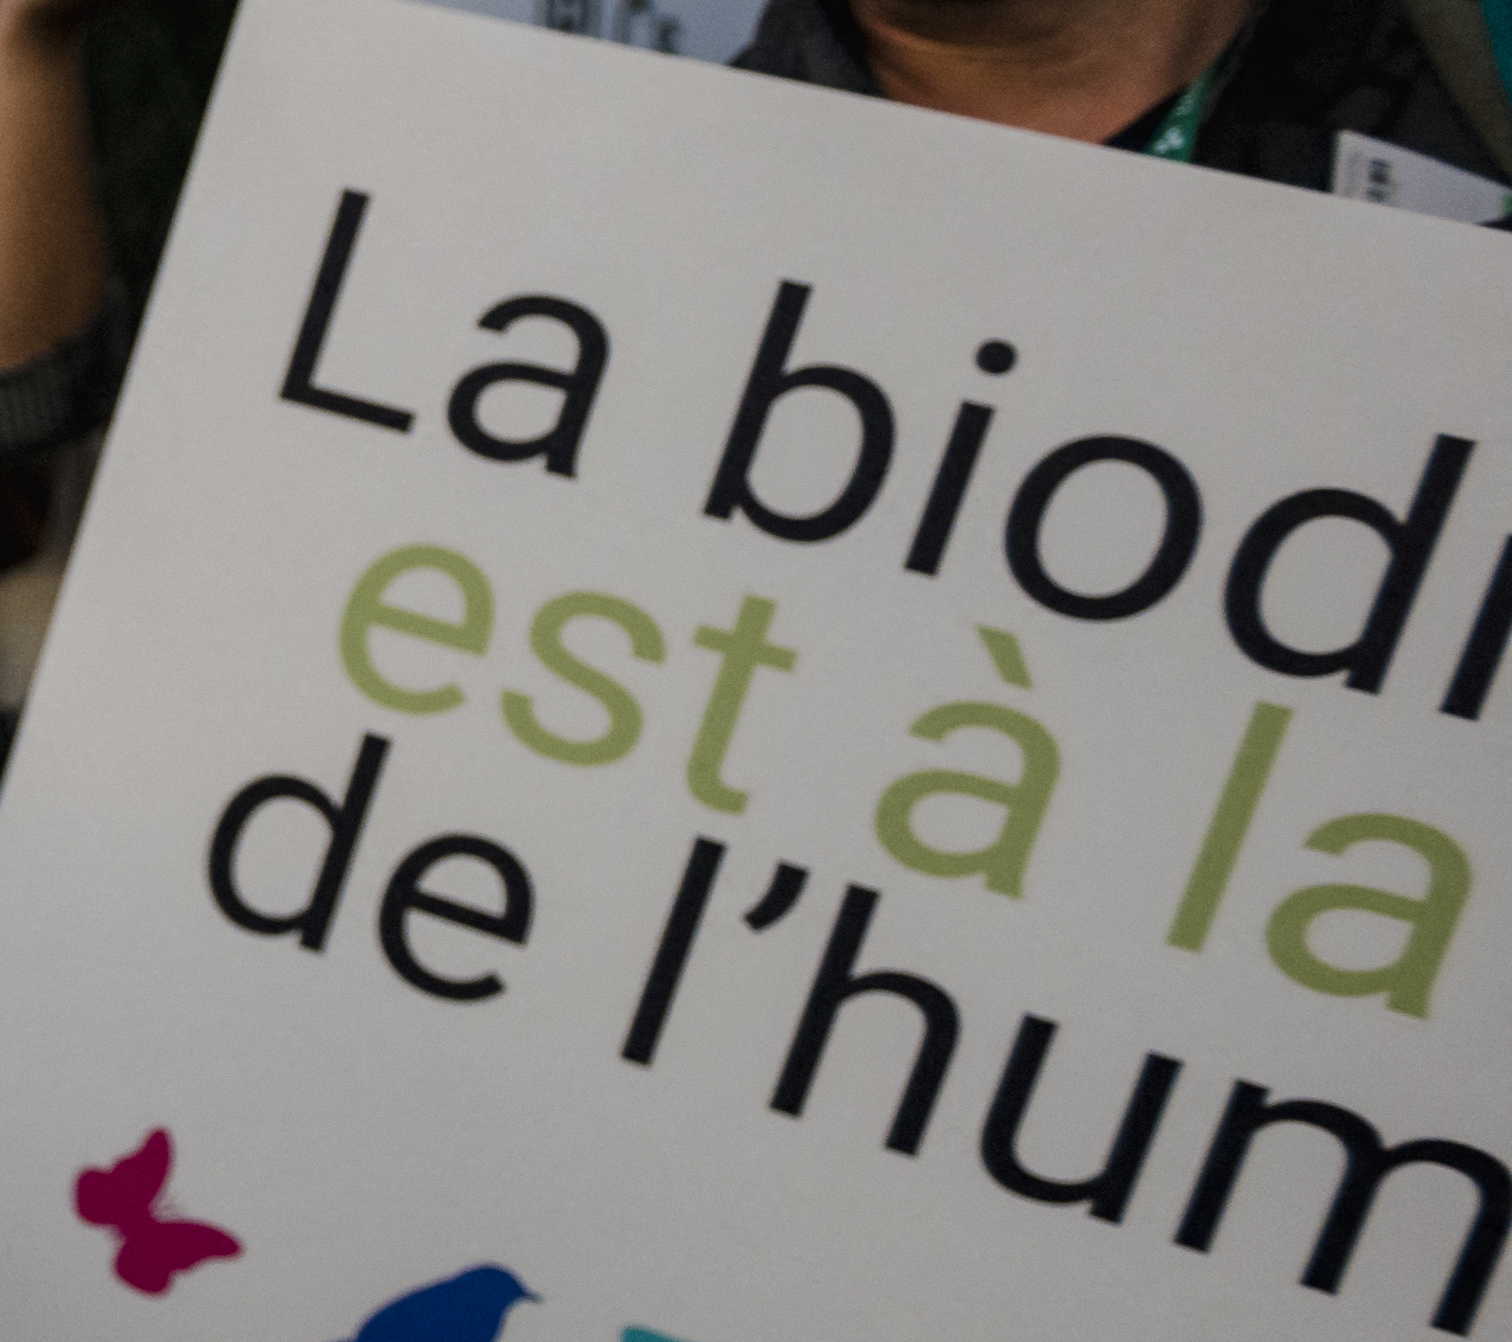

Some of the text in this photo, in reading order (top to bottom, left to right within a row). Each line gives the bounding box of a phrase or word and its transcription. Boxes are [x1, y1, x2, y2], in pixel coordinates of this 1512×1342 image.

[279, 189, 613, 480] La
[205, 733, 537, 1004] de
[339, 543, 799, 817] est
[872, 625, 1062, 902] à
[1166, 702, 1476, 1023] la
